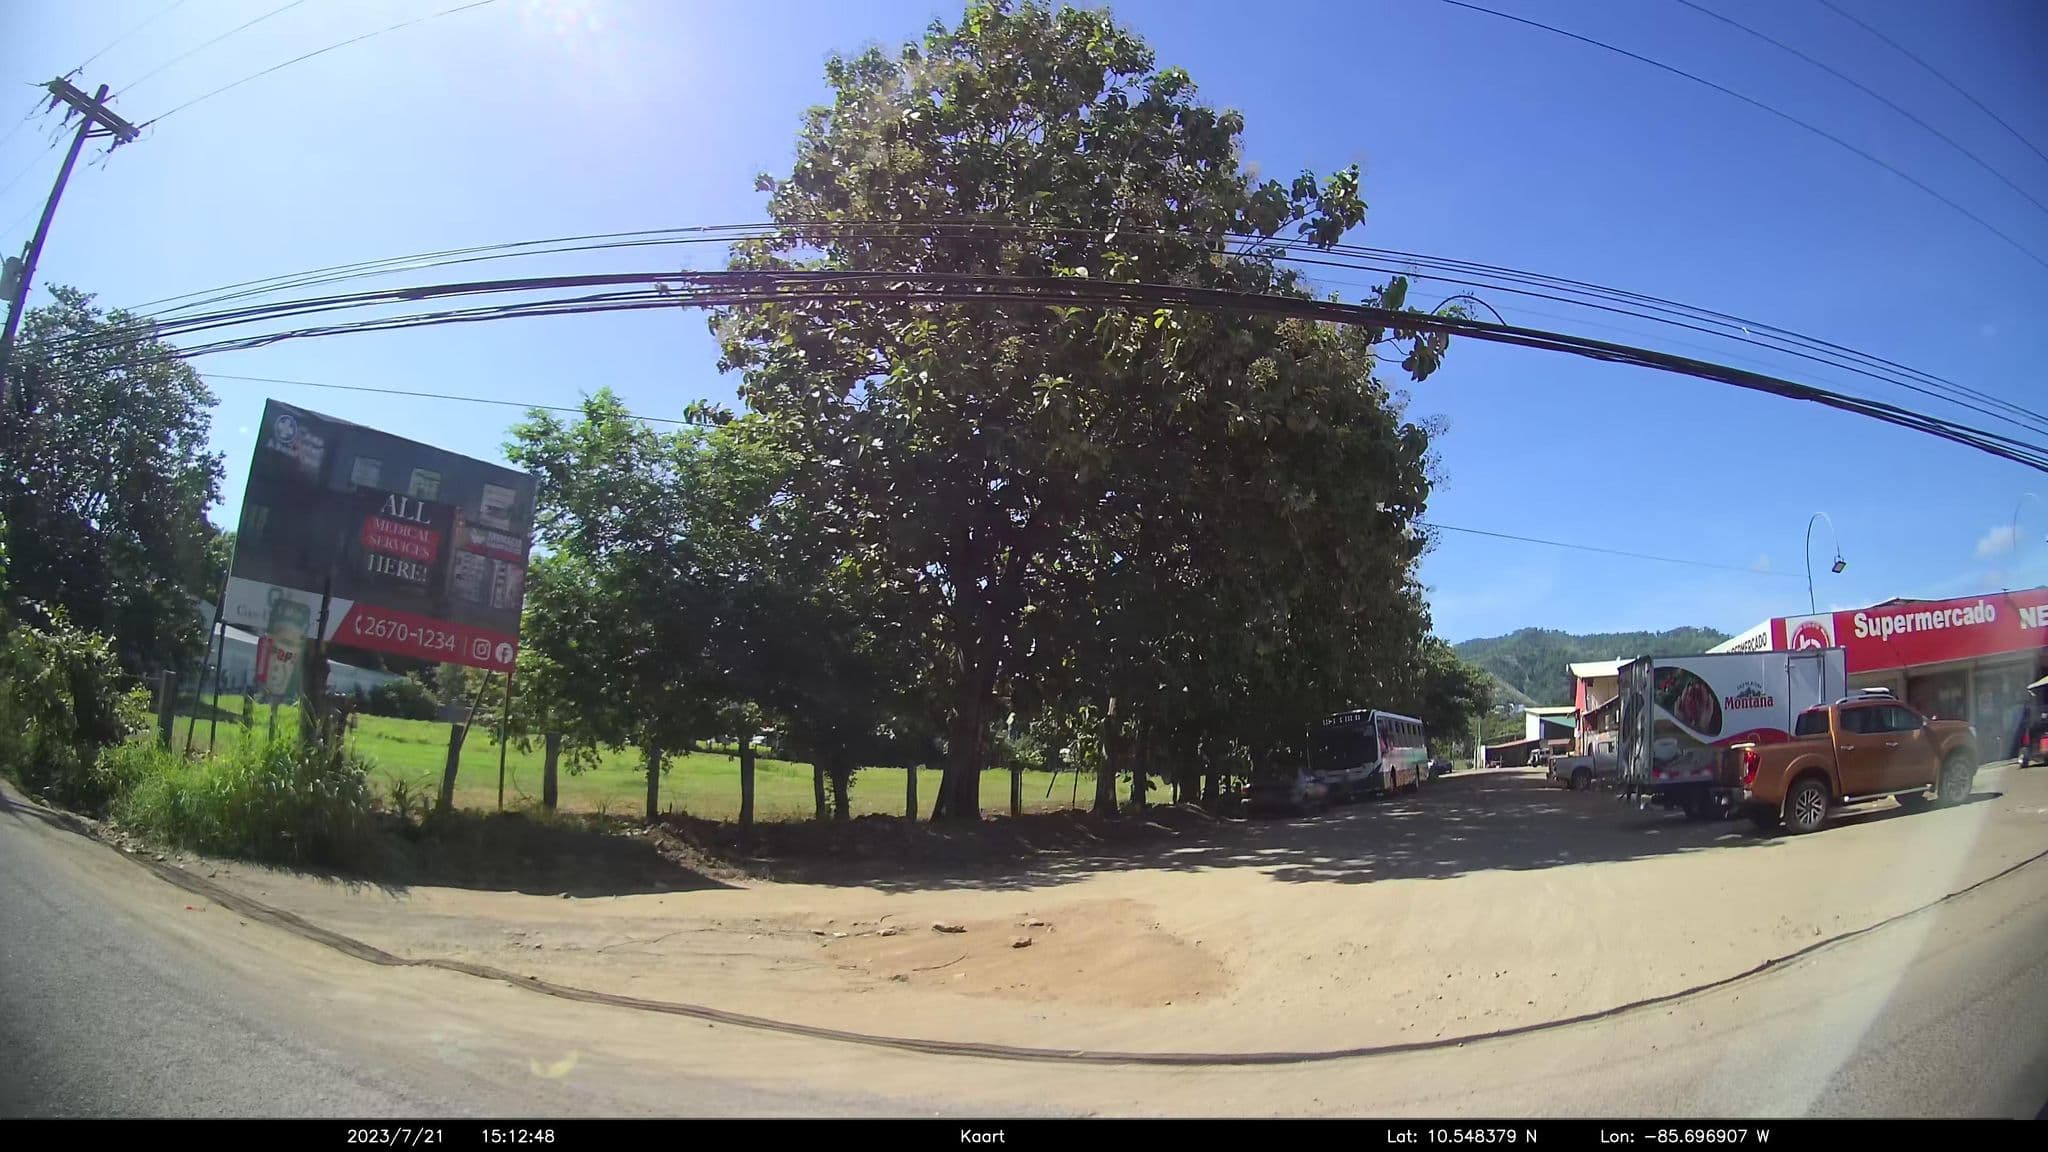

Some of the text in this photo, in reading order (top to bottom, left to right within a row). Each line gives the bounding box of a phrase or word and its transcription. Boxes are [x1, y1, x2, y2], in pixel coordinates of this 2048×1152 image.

[382, 493, 431, 525] ALL
[374, 518, 431, 543] MEDICAL
[368, 535, 431, 558] SERVICES
[367, 553, 429, 583] HERE!
[364, 616, 456, 652] 2670-1234
[1854, 600, 1996, 642] Supermercado
